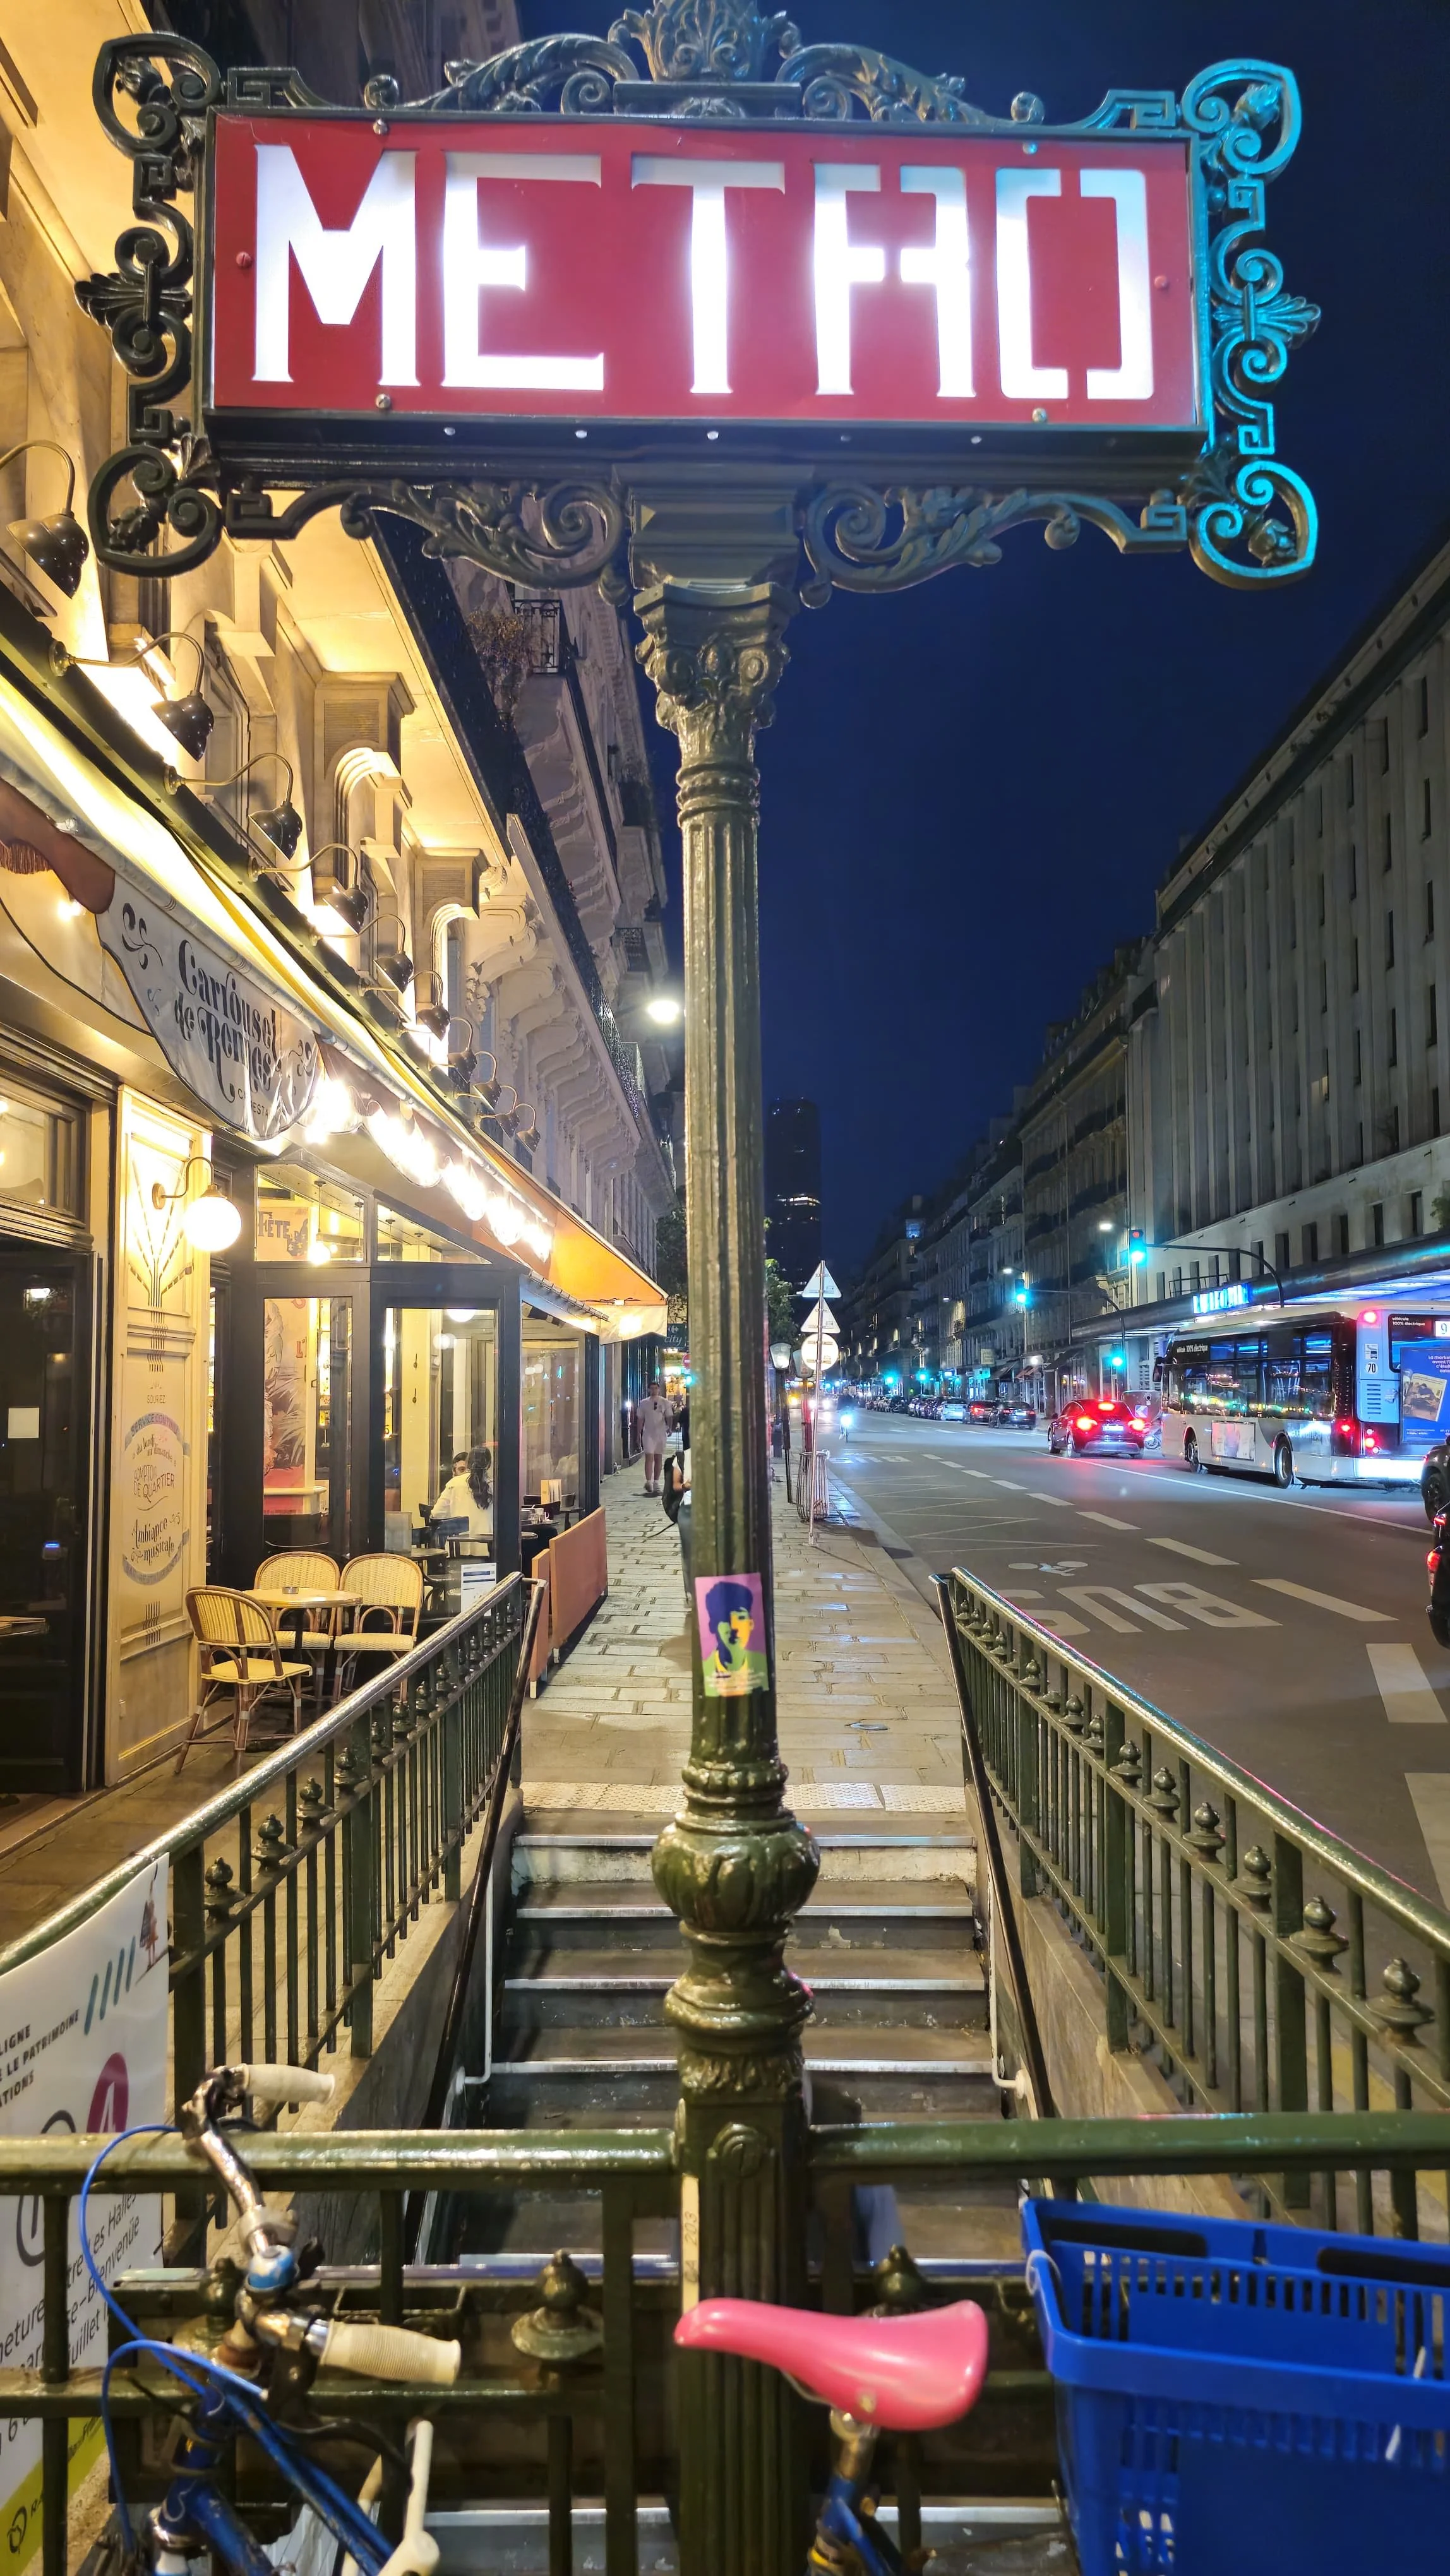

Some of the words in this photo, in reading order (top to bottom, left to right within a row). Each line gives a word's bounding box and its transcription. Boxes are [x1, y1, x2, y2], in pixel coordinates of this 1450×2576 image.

[252, 144, 1154, 400] METRO
[174, 991, 195, 1041] de
[178, 939, 281, 1072] Carrousel
[664, 1335, 682, 1346] city
[1368, 1363, 1376, 1373] 70
[133, 1480, 141, 1497] DE
[143, 1472, 175, 1503] QUARTIER
[131, 1518, 167, 1549] Ambiance
[144, 1535, 175, 1566] musicale
[23, 2008, 80, 2066] PATRIMOINE
